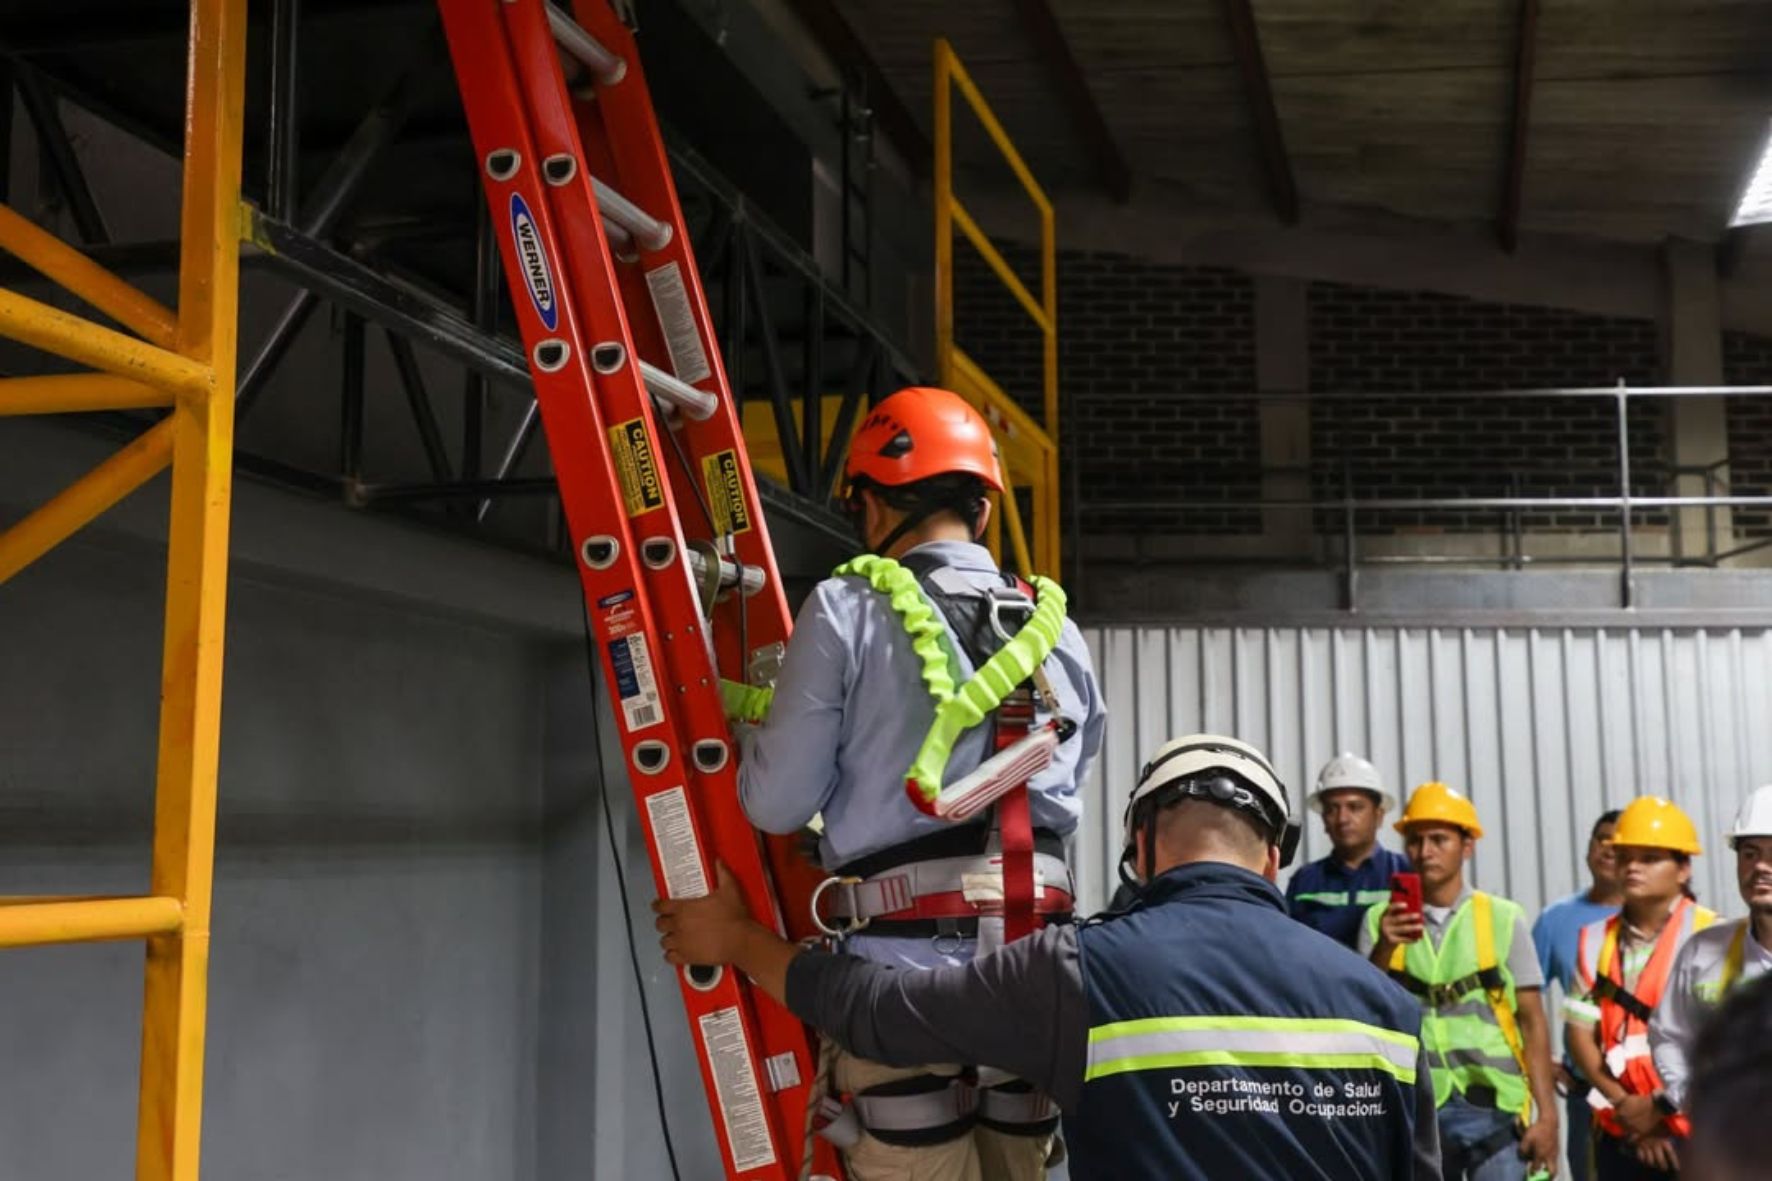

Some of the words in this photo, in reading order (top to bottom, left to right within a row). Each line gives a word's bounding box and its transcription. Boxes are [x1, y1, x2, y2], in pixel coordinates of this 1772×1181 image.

[518, 222, 549, 302] WERNER
[632, 428, 659, 500] CAUTION
[723, 458, 746, 524] CAUTION
[1167, 1101, 1180, 1118] y
[1190, 1095, 1279, 1115] Seguridad
[1170, 1077, 1304, 1097] Departamento
[1313, 1080, 1335, 1098] de
[1344, 1081, 1382, 1098] Salud
